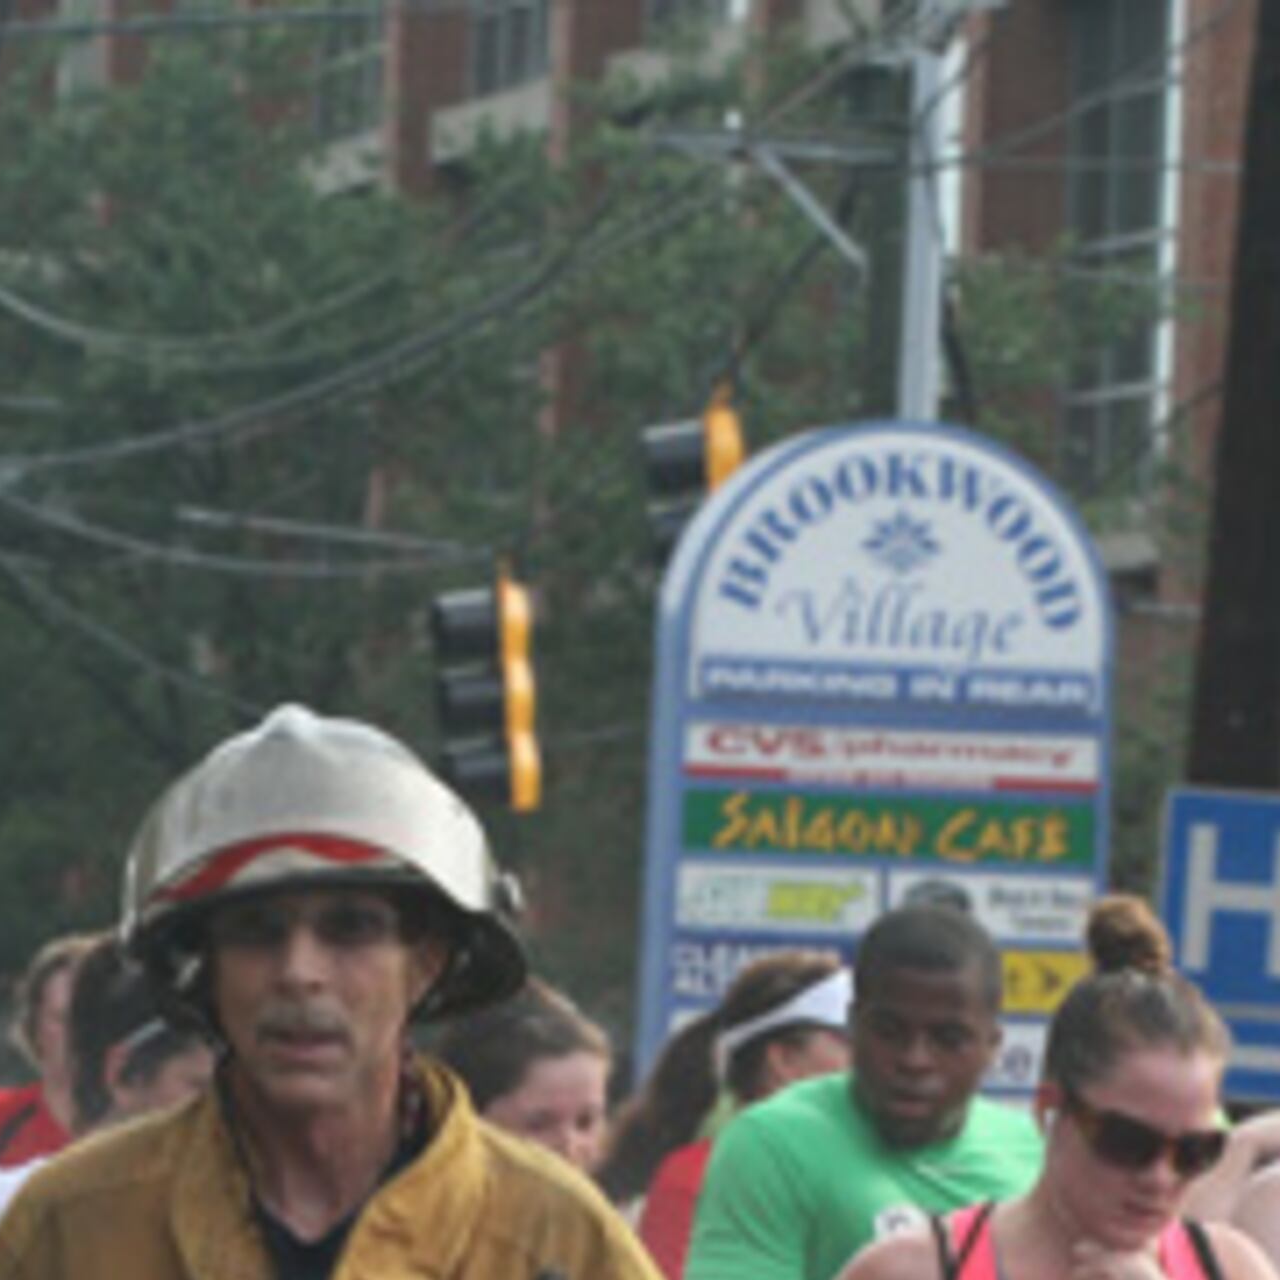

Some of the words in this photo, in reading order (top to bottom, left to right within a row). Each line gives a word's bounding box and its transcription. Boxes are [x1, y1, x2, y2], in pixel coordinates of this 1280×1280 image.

[719, 453, 1082, 630] BROOKWOOD
[774, 576, 1026, 660] Village
[704, 668, 900, 698] PARKING
[908, 673, 956, 701] IN
